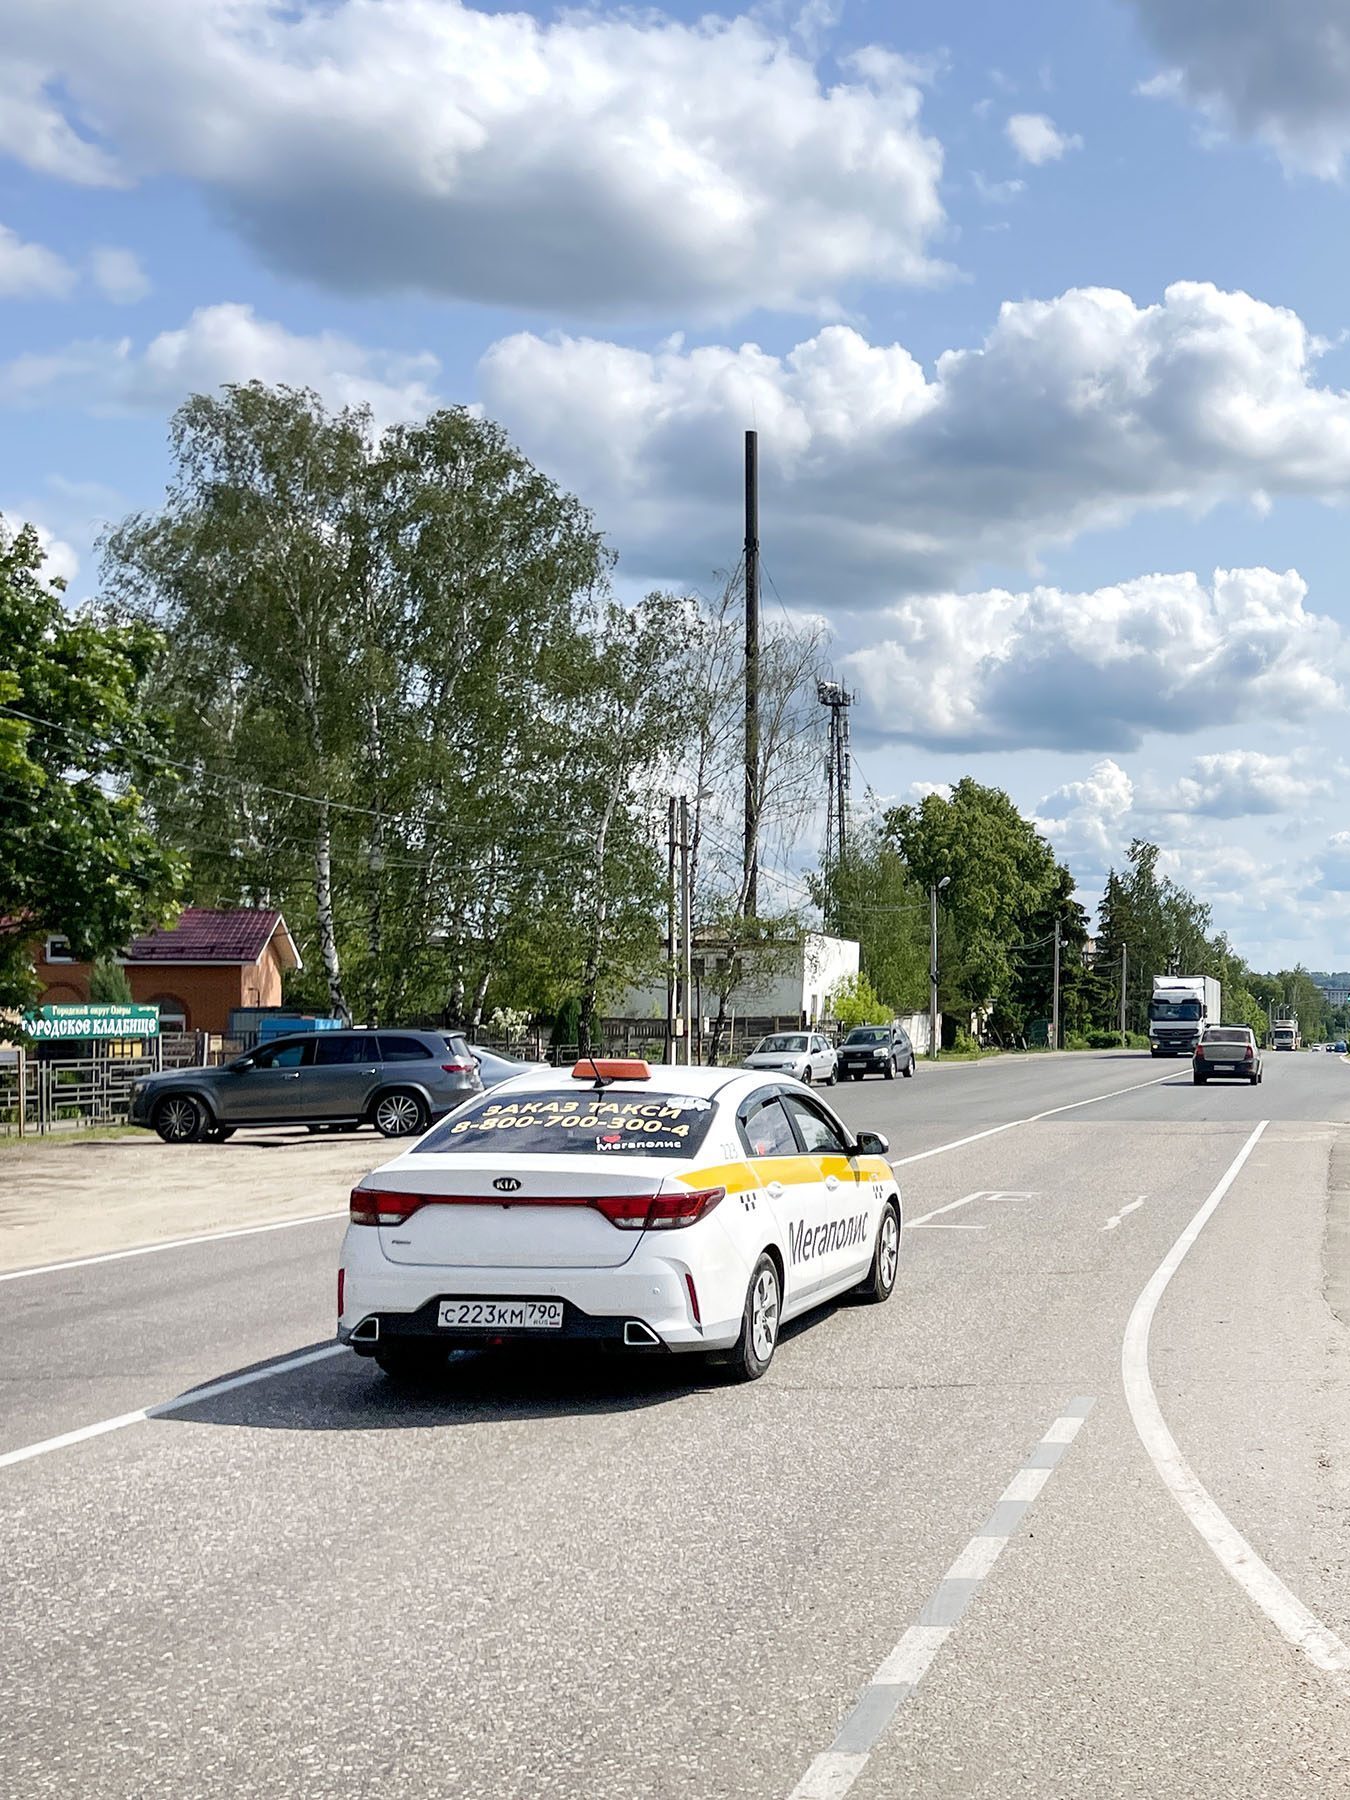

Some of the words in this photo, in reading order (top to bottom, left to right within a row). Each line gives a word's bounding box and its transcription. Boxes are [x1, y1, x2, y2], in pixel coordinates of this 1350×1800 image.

[90, 1008, 109, 1017] округ
[92, 1018, 156, 1037] КЛАДБИЩЕ
[481, 1101, 579, 1118] ЗАКАЗ
[588, 1102, 682, 1120] ТАКСИ
[451, 1115, 690, 1138] 8-800-700-300-4
[596, 1140, 682, 1151] Мегаполис
[496, 1179, 518, 1189] KIA
[789, 1212, 868, 1266] Мегаполис
[528, 1304, 557, 1319] 790
